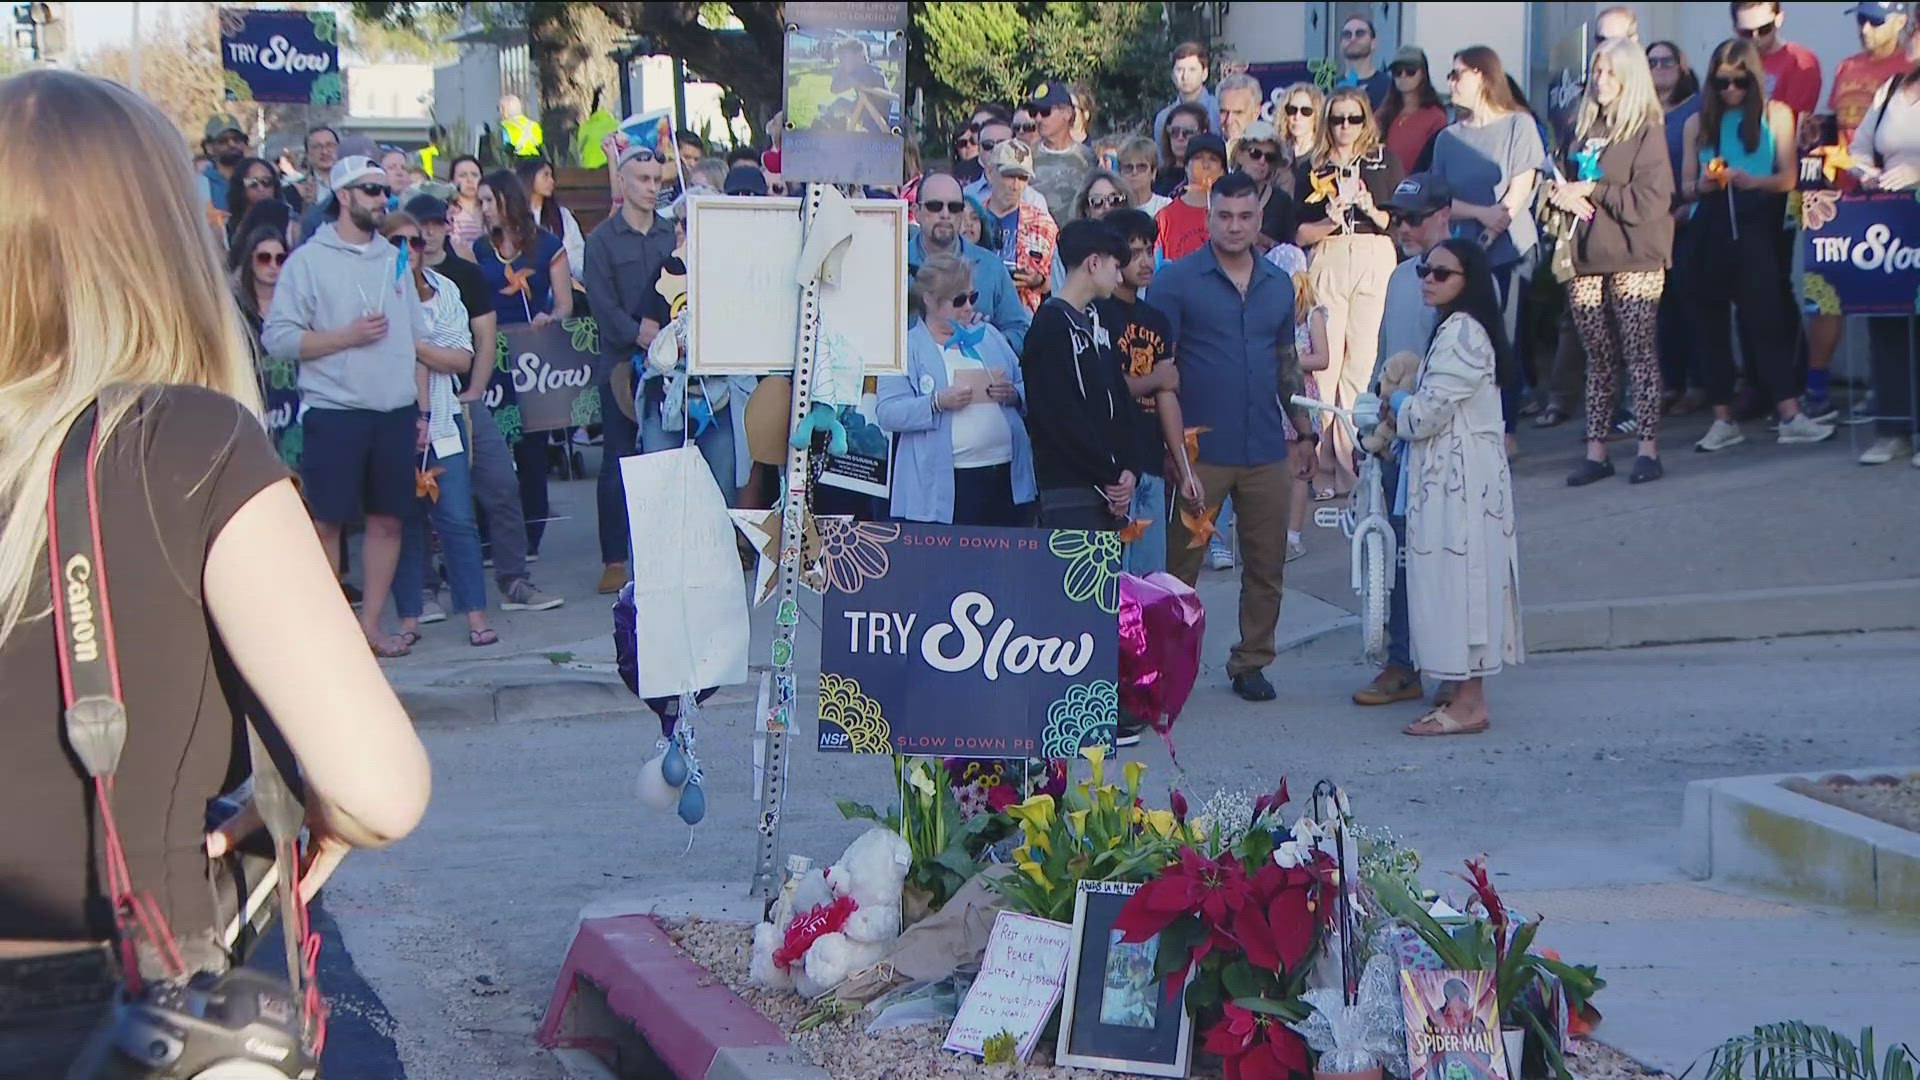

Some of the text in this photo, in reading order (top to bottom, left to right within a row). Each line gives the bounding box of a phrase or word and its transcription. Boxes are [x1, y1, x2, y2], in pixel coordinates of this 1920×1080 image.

[227, 35, 330, 74] TRY Slow
[1812, 237, 1851, 262] TRY
[511, 352, 592, 394] Slow
[903, 535, 1039, 550] SLOW DOWN PB
[66, 553, 98, 662] Canon
[843, 591, 1095, 681] TRY Slow
[820, 733, 849, 745] NSP
[897, 736, 1034, 750] SLOW DOWN PB
[1413, 1030, 1496, 1056] SPIDER-MAN
